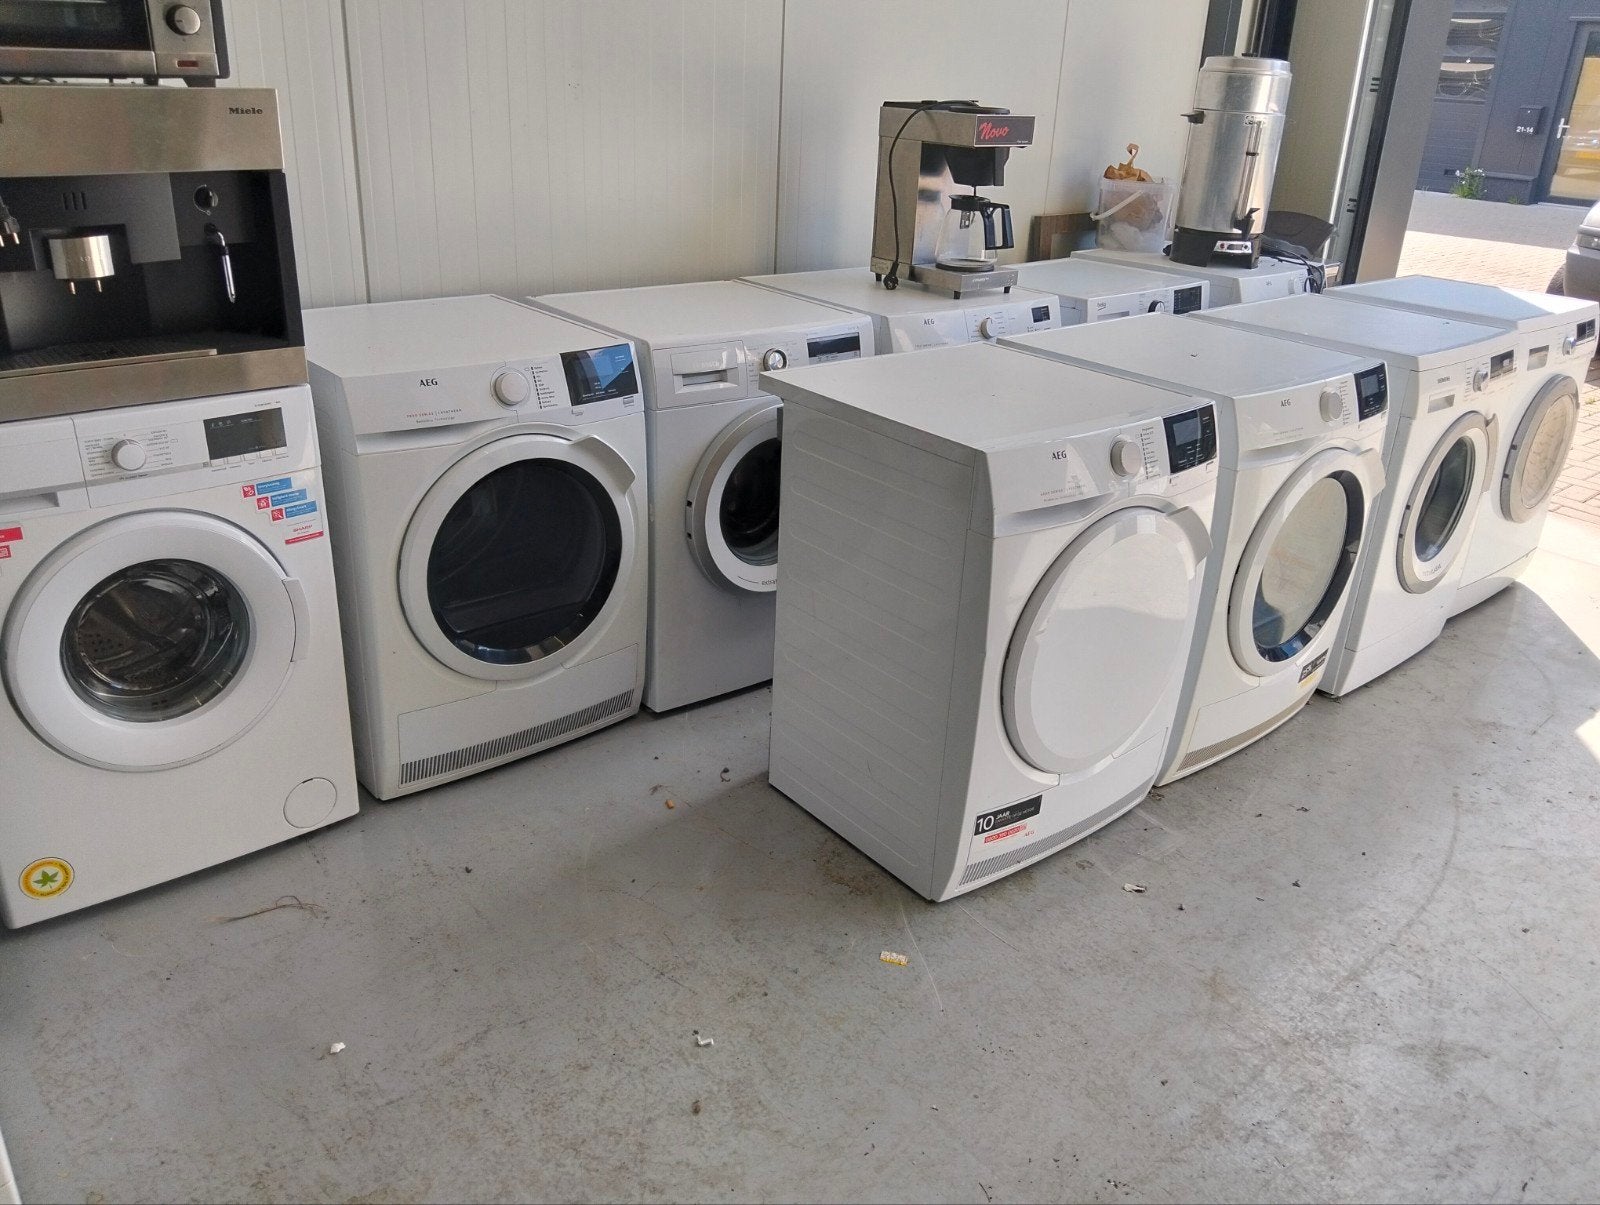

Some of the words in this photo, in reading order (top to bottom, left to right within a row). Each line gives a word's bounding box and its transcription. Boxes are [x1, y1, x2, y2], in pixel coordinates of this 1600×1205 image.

[228, 107, 263, 115] Miele
[979, 122, 1009, 140] Novo
[923, 318, 935, 326] AEG
[419, 378, 438, 387] AEG
[1280, 399, 1291, 407] AEG
[1051, 449, 1067, 460] AEG
[976, 815, 995, 833] 10
